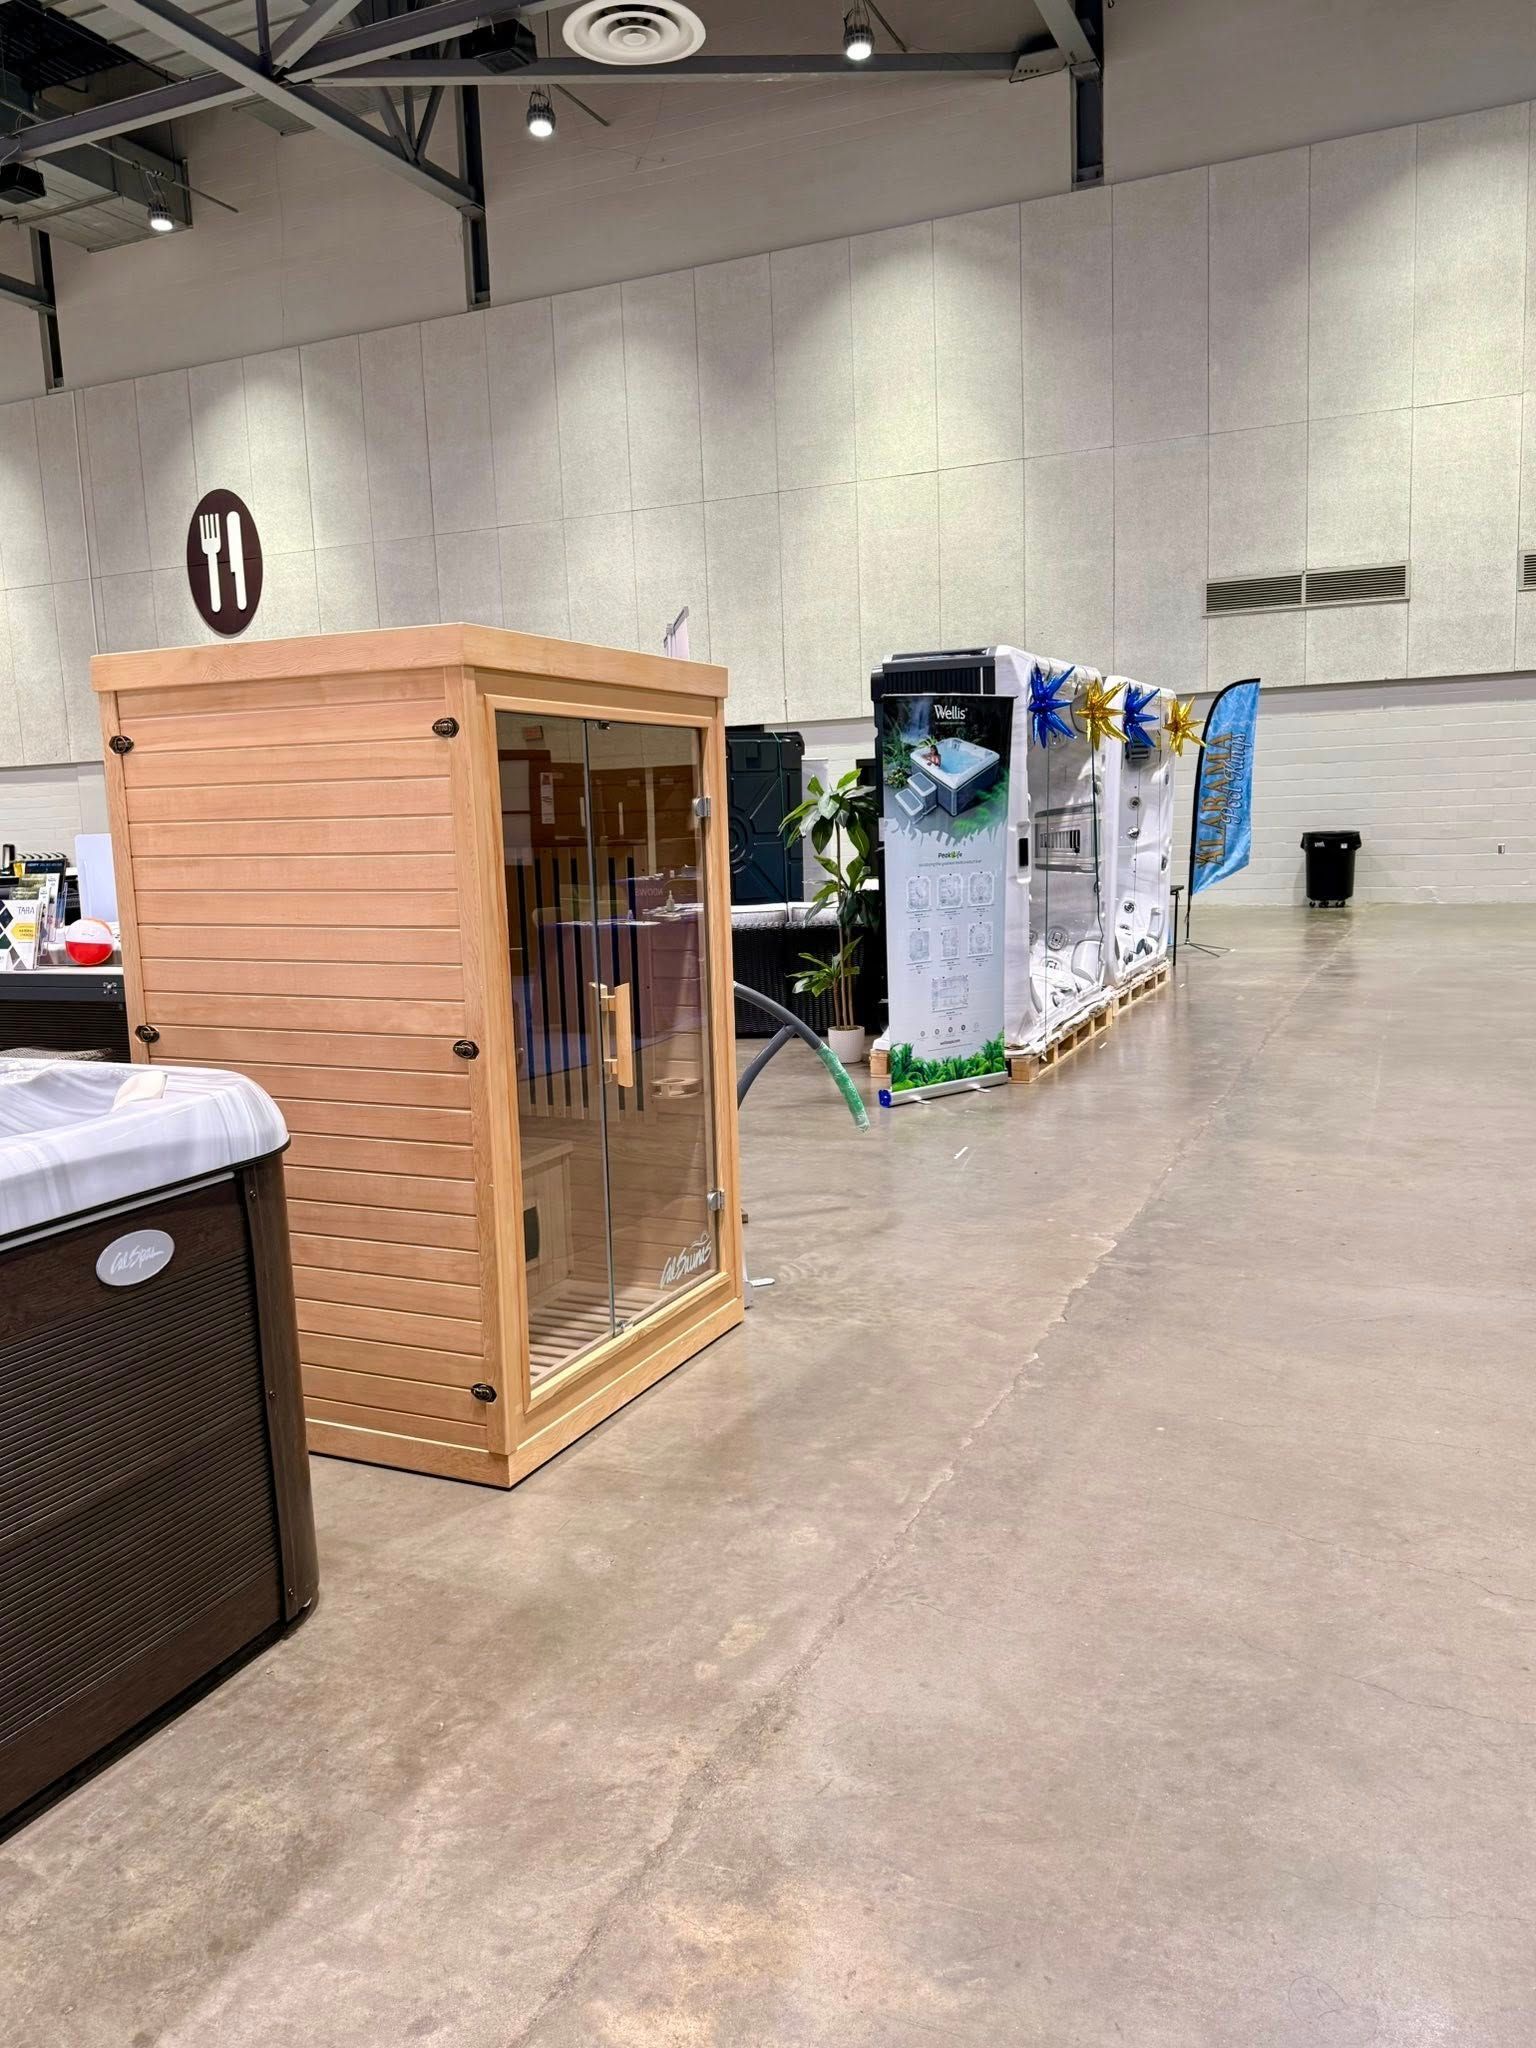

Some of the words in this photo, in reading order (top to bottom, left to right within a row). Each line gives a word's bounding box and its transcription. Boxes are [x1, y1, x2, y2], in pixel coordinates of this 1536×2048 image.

[933, 704, 966, 720] Wellis
[1223, 733, 1252, 780] Kings
[1196, 731, 1232, 866] ALABAMA
[1221, 786, 1242, 824] Pool
[17, 906, 35, 915] TARA
